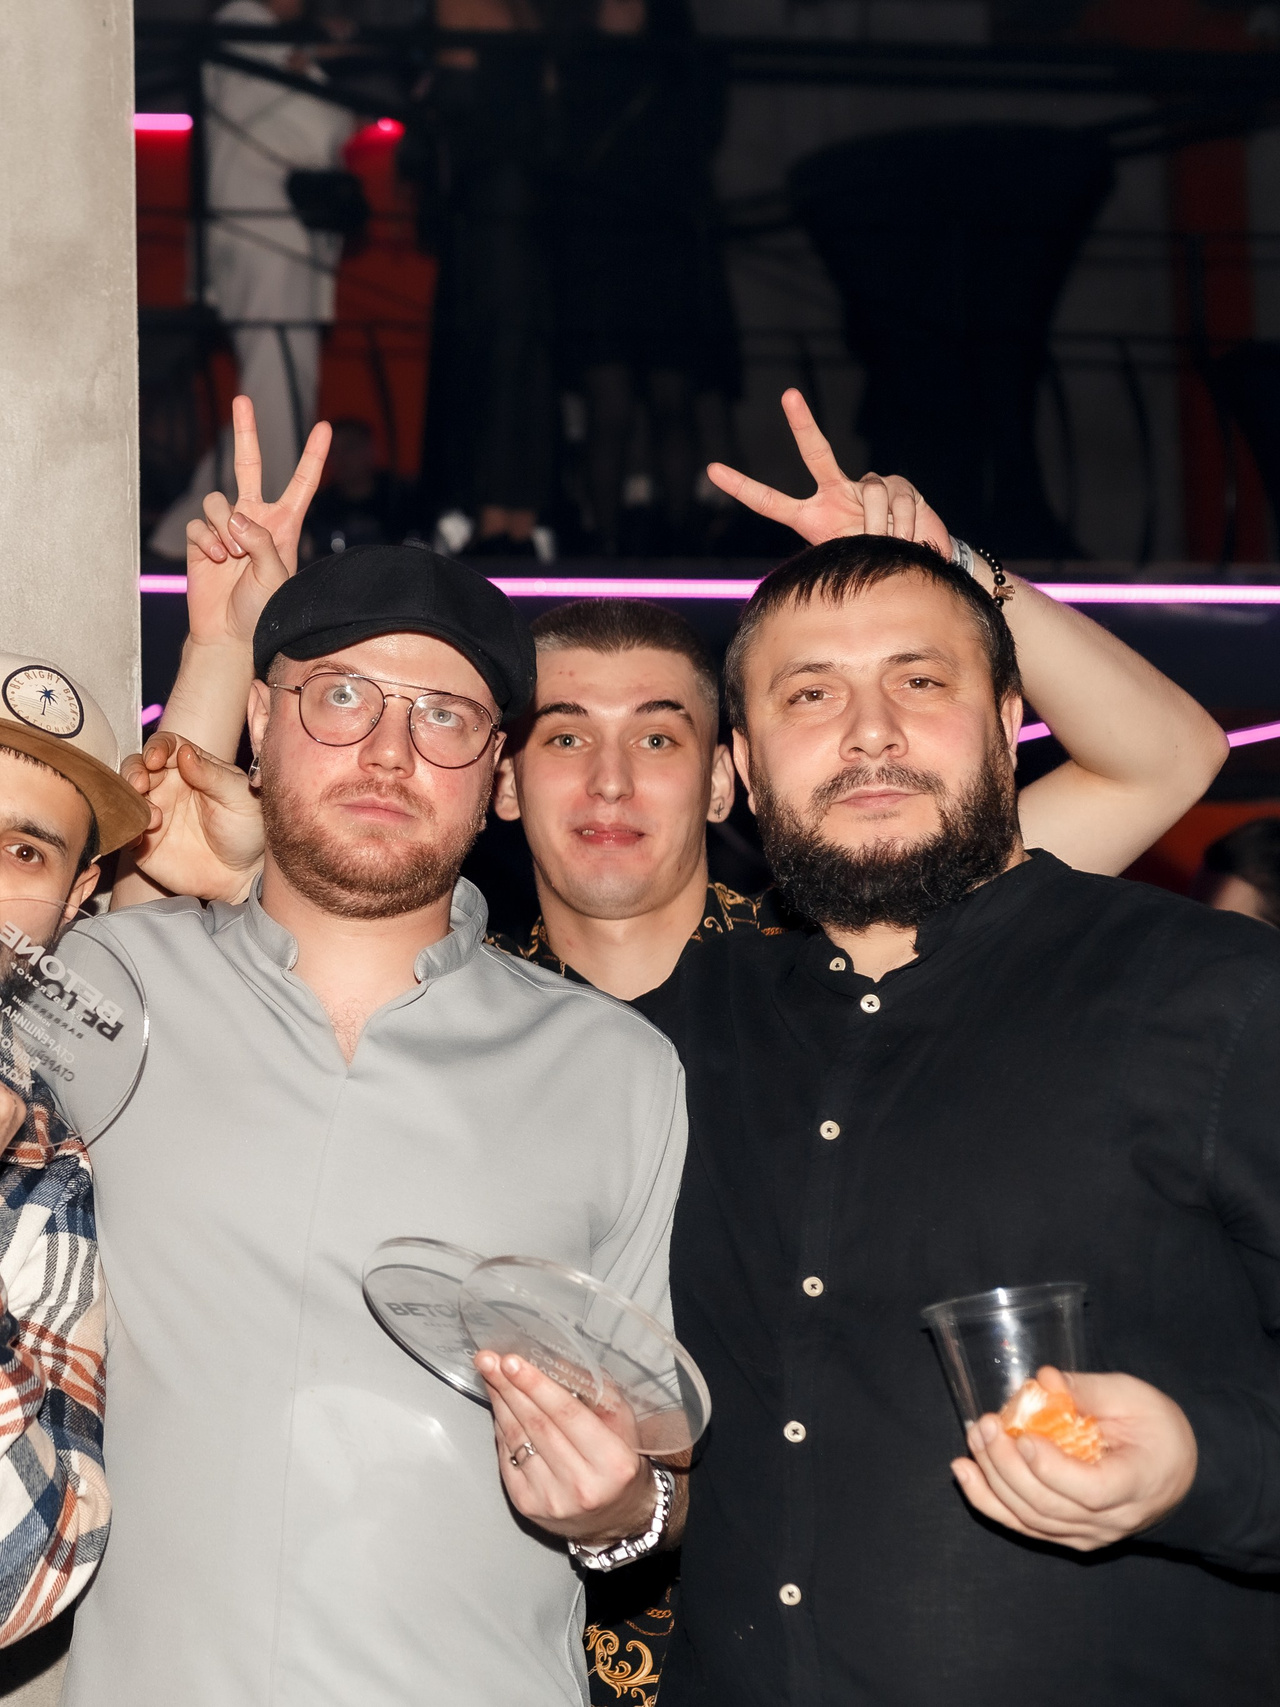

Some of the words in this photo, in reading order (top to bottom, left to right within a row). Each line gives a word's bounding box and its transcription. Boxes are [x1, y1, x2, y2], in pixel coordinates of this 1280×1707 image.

[9, 678, 25, 690] BE
[24, 670, 62, 684] RIGHT
[62, 687, 79, 717] BACK
